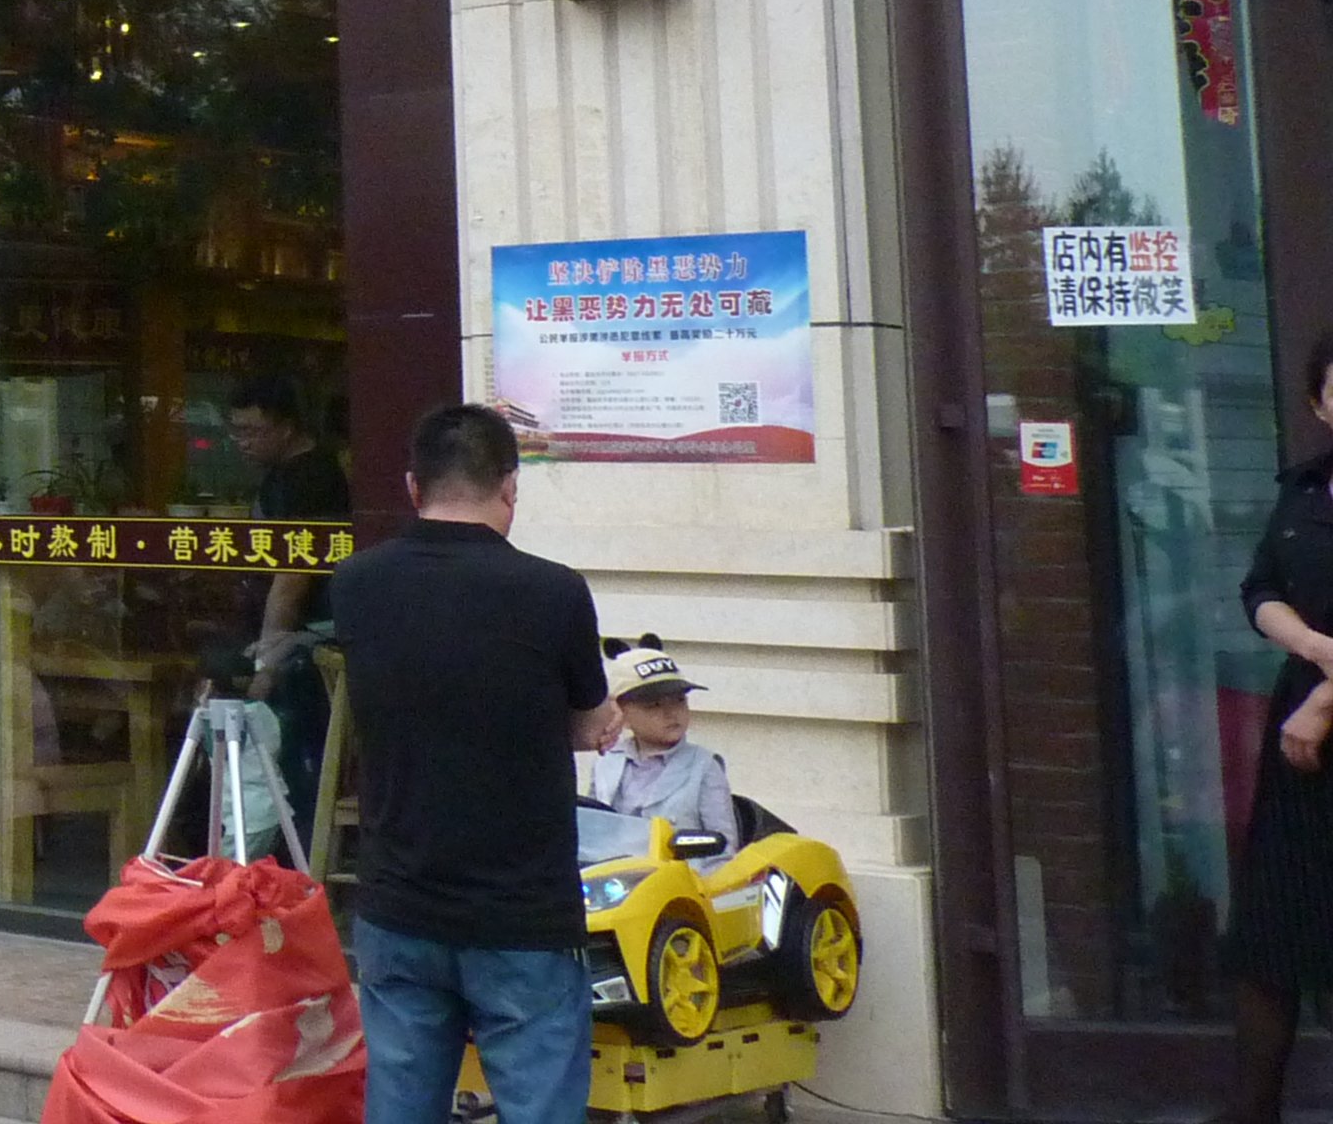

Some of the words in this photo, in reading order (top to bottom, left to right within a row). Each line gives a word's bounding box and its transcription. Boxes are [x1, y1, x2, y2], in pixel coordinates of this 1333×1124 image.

[1052, 230, 1181, 274] 店内有监控
[547, 253, 749, 287] 坚决铲除黑恶势力
[525, 289, 774, 323] 让黑恶势力无处可藏
[1054, 276, 1189, 319] 请保持微笑
[622, 350, 669, 362] 举报方式
[636, 658, 675, 677] BUY
